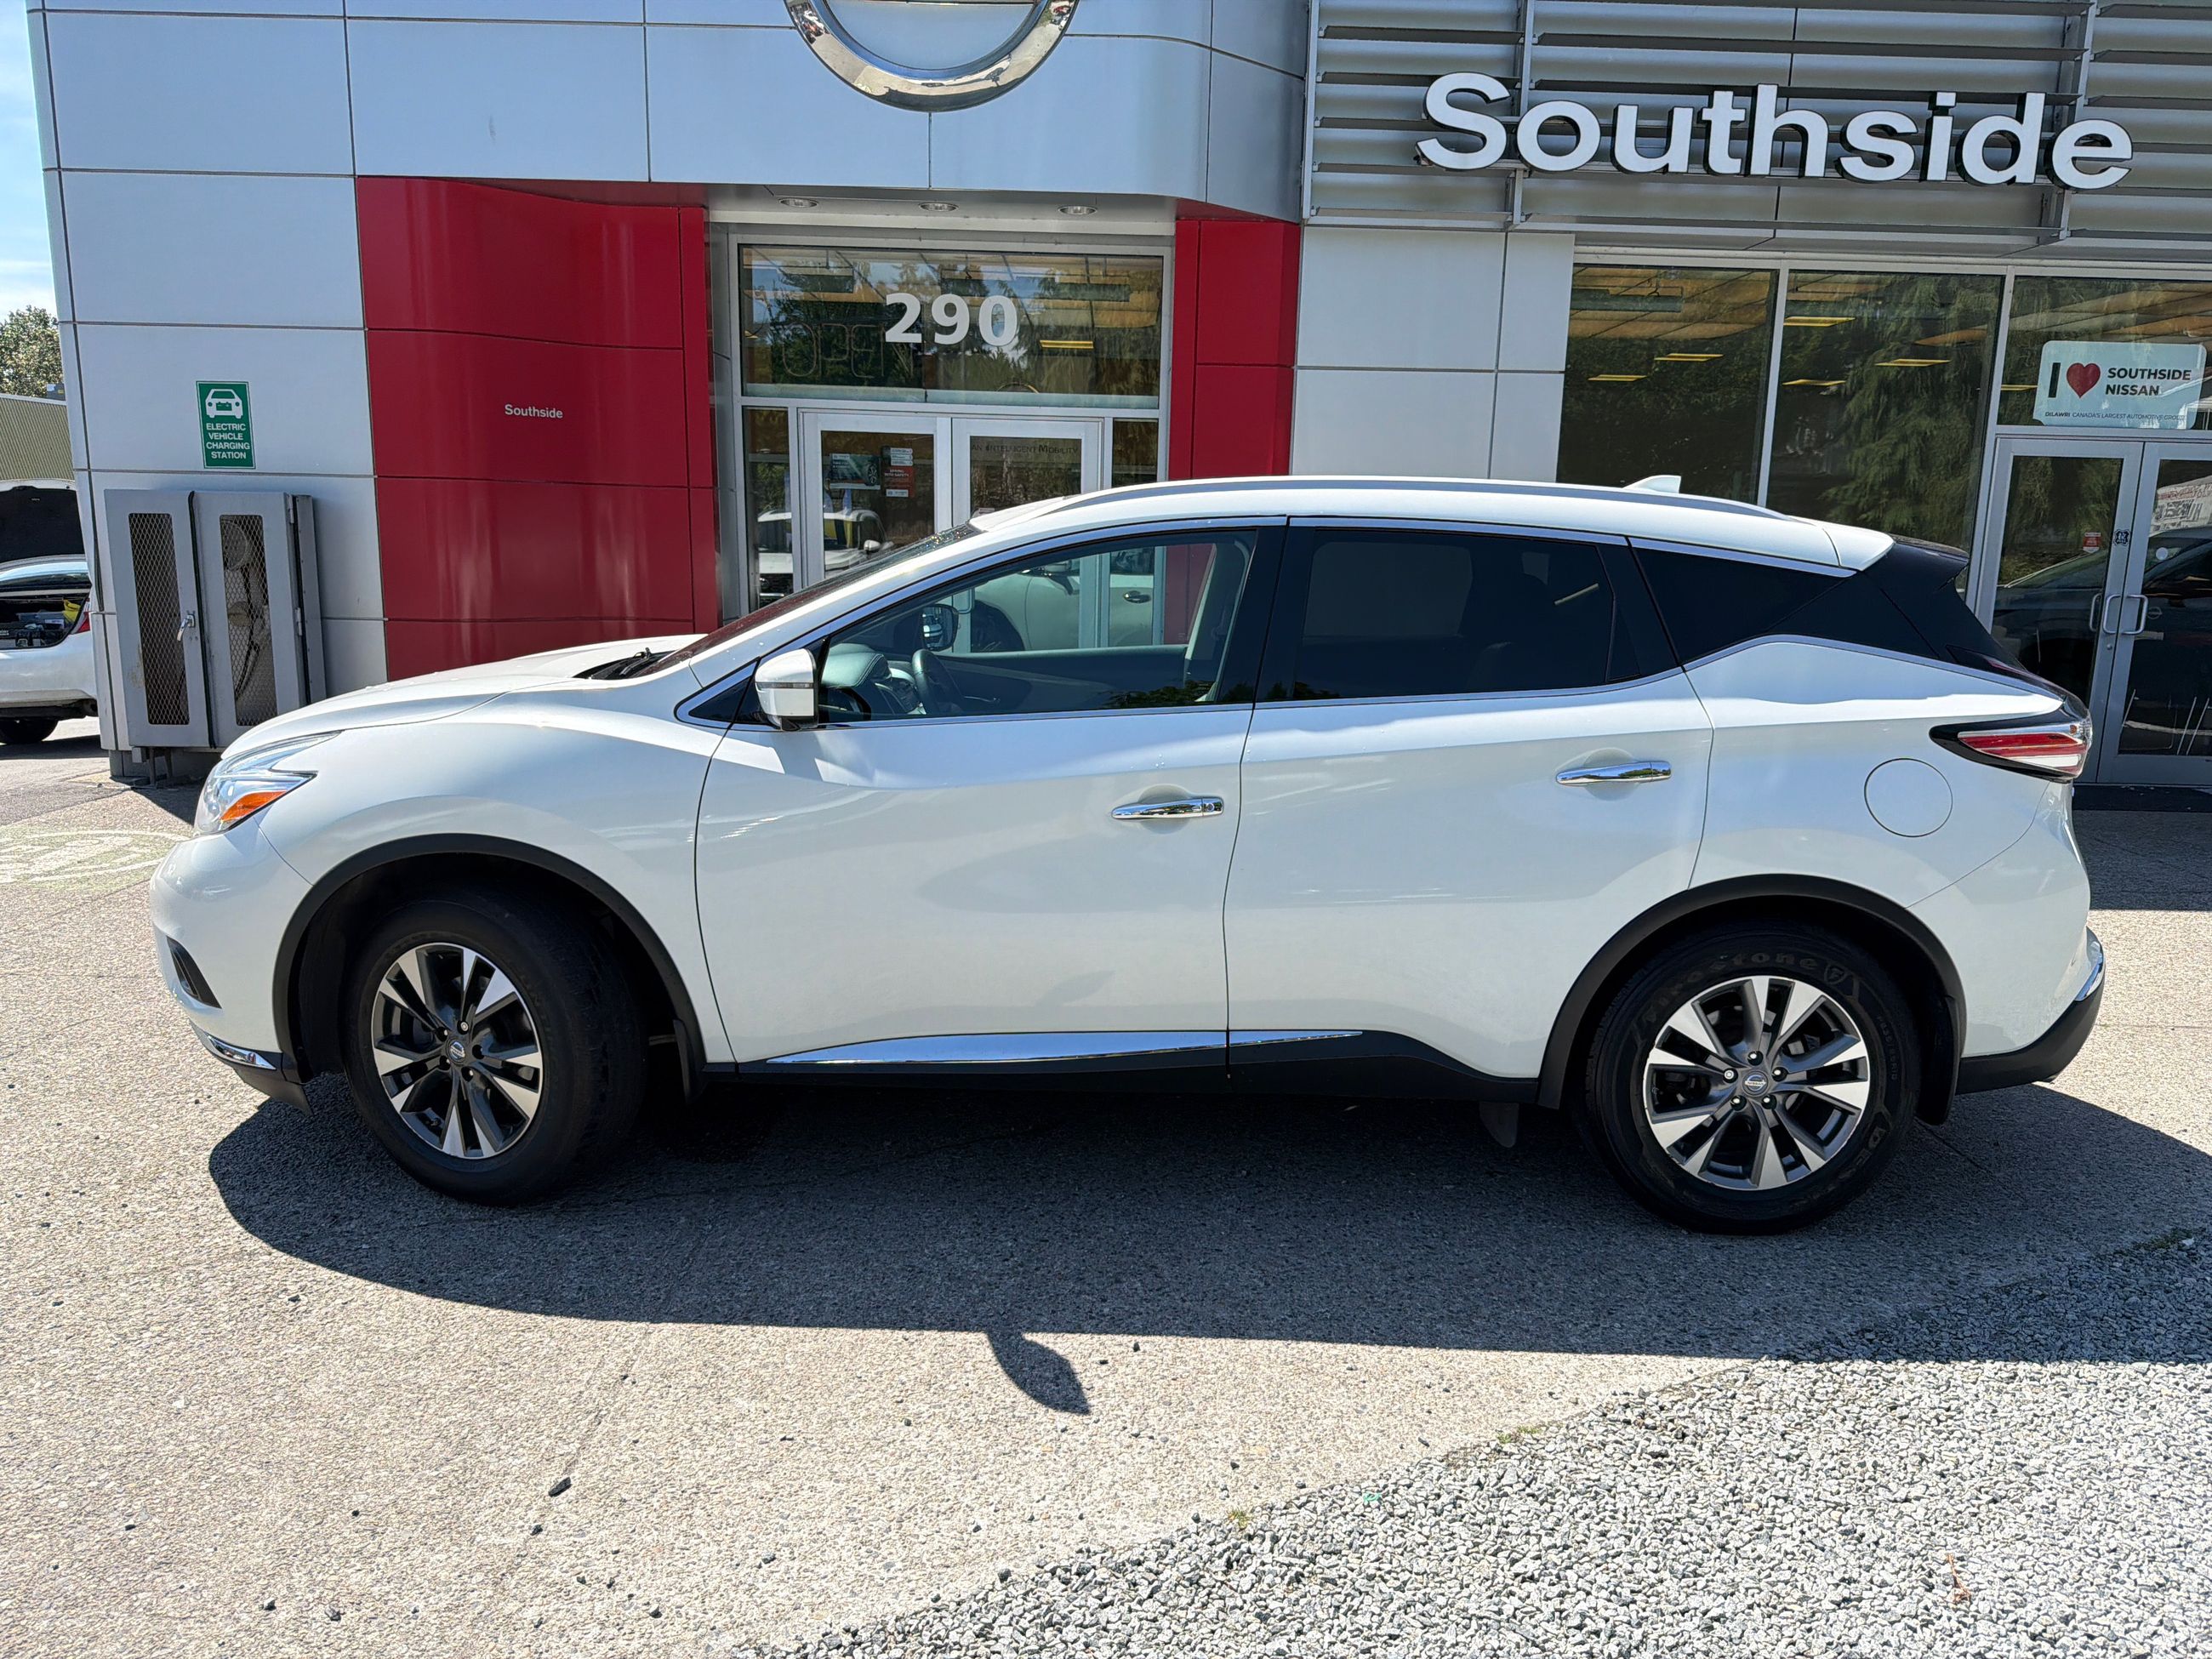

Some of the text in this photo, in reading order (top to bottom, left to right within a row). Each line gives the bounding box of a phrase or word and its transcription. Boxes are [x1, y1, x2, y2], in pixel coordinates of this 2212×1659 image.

[1415, 71, 2133, 190] Southside
[885, 293, 1018, 346] 290
[2048, 362, 2061, 398] I
[2107, 367, 2192, 381] SOUTHSIDE
[2105, 385, 2160, 396] NISSAN
[504, 403, 564, 419] Southside
[206, 422, 246, 430] ELECTRIC
[206, 442, 250, 450] CHARGING
[211, 451, 247, 459] STATION
